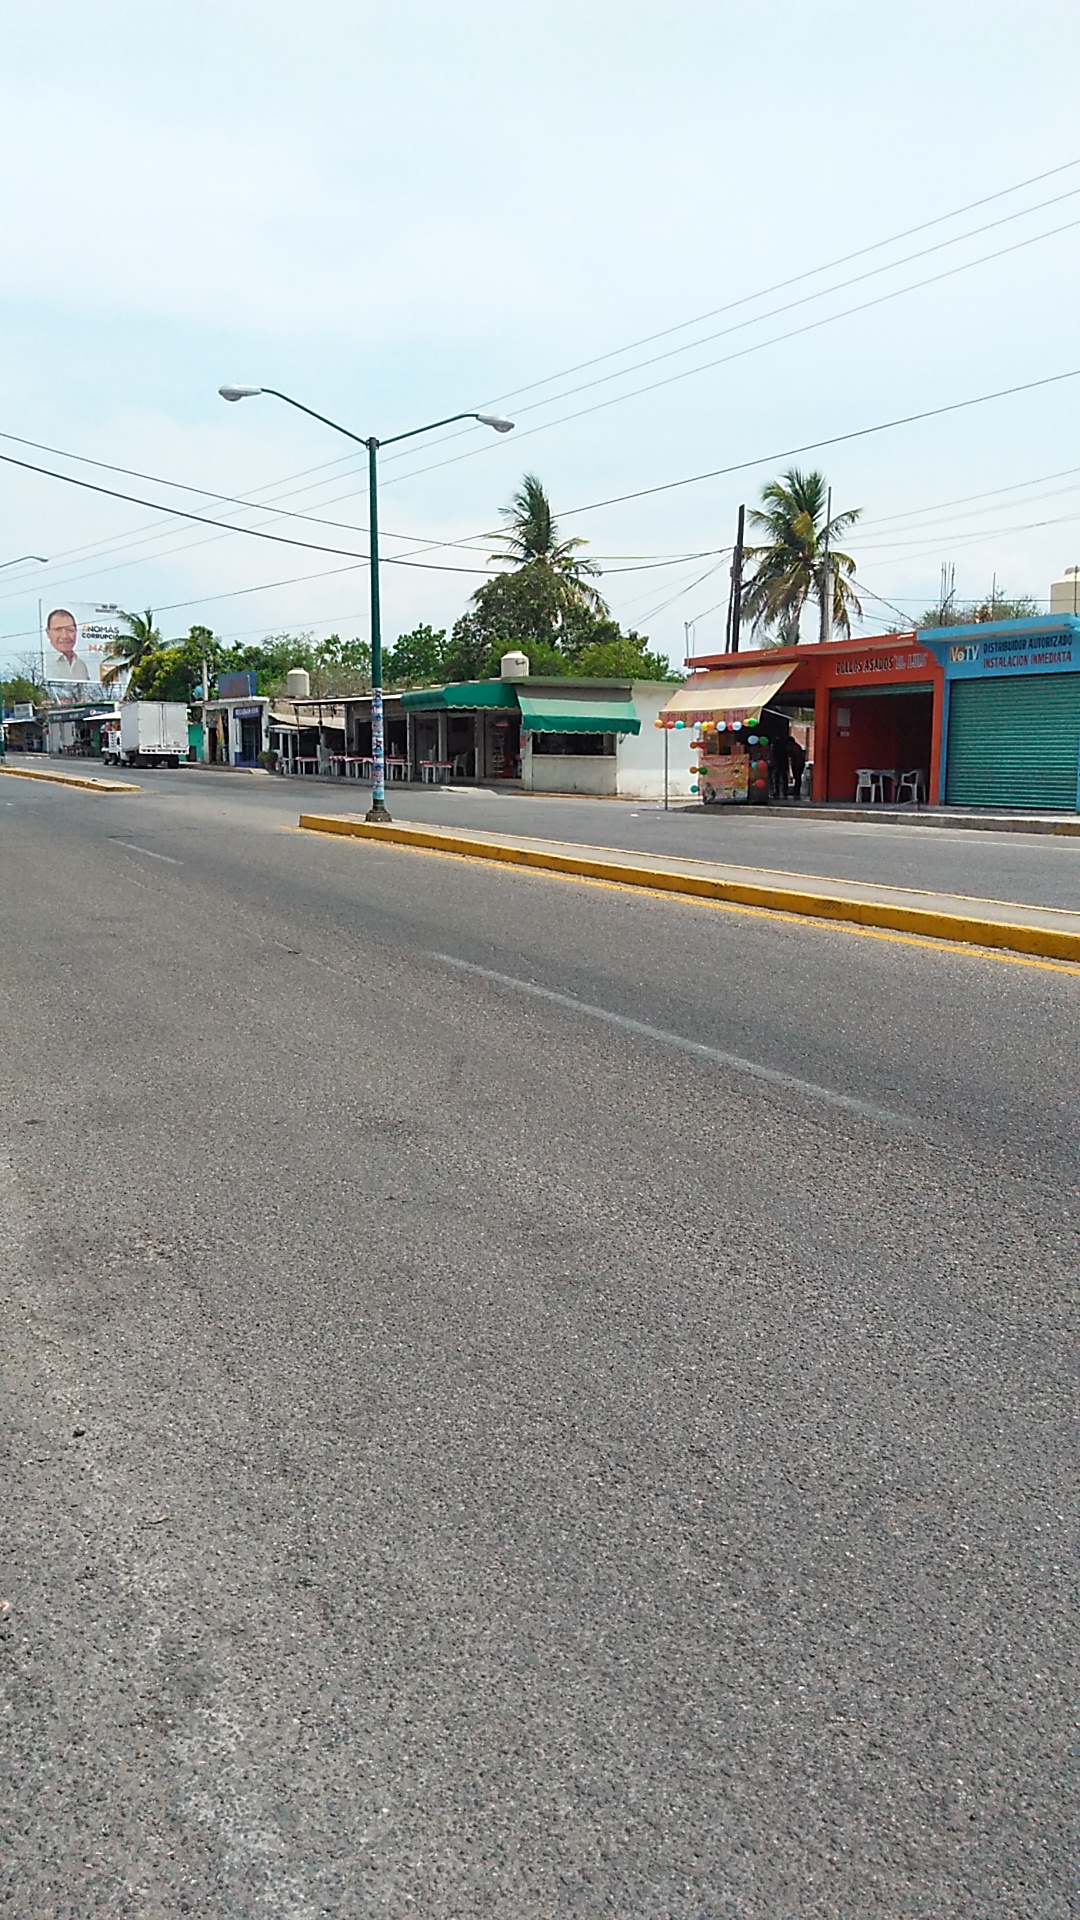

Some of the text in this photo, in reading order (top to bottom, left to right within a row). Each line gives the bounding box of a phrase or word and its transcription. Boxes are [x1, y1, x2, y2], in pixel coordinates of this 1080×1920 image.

[983, 634, 1073, 654] DISTRIBUIDOR AUTORIZADO
[835, 661, 862, 676] POLLOS
[862, 656, 894, 673] ASADOS
[983, 650, 1072, 669] INSTALACION INMEDIATA
